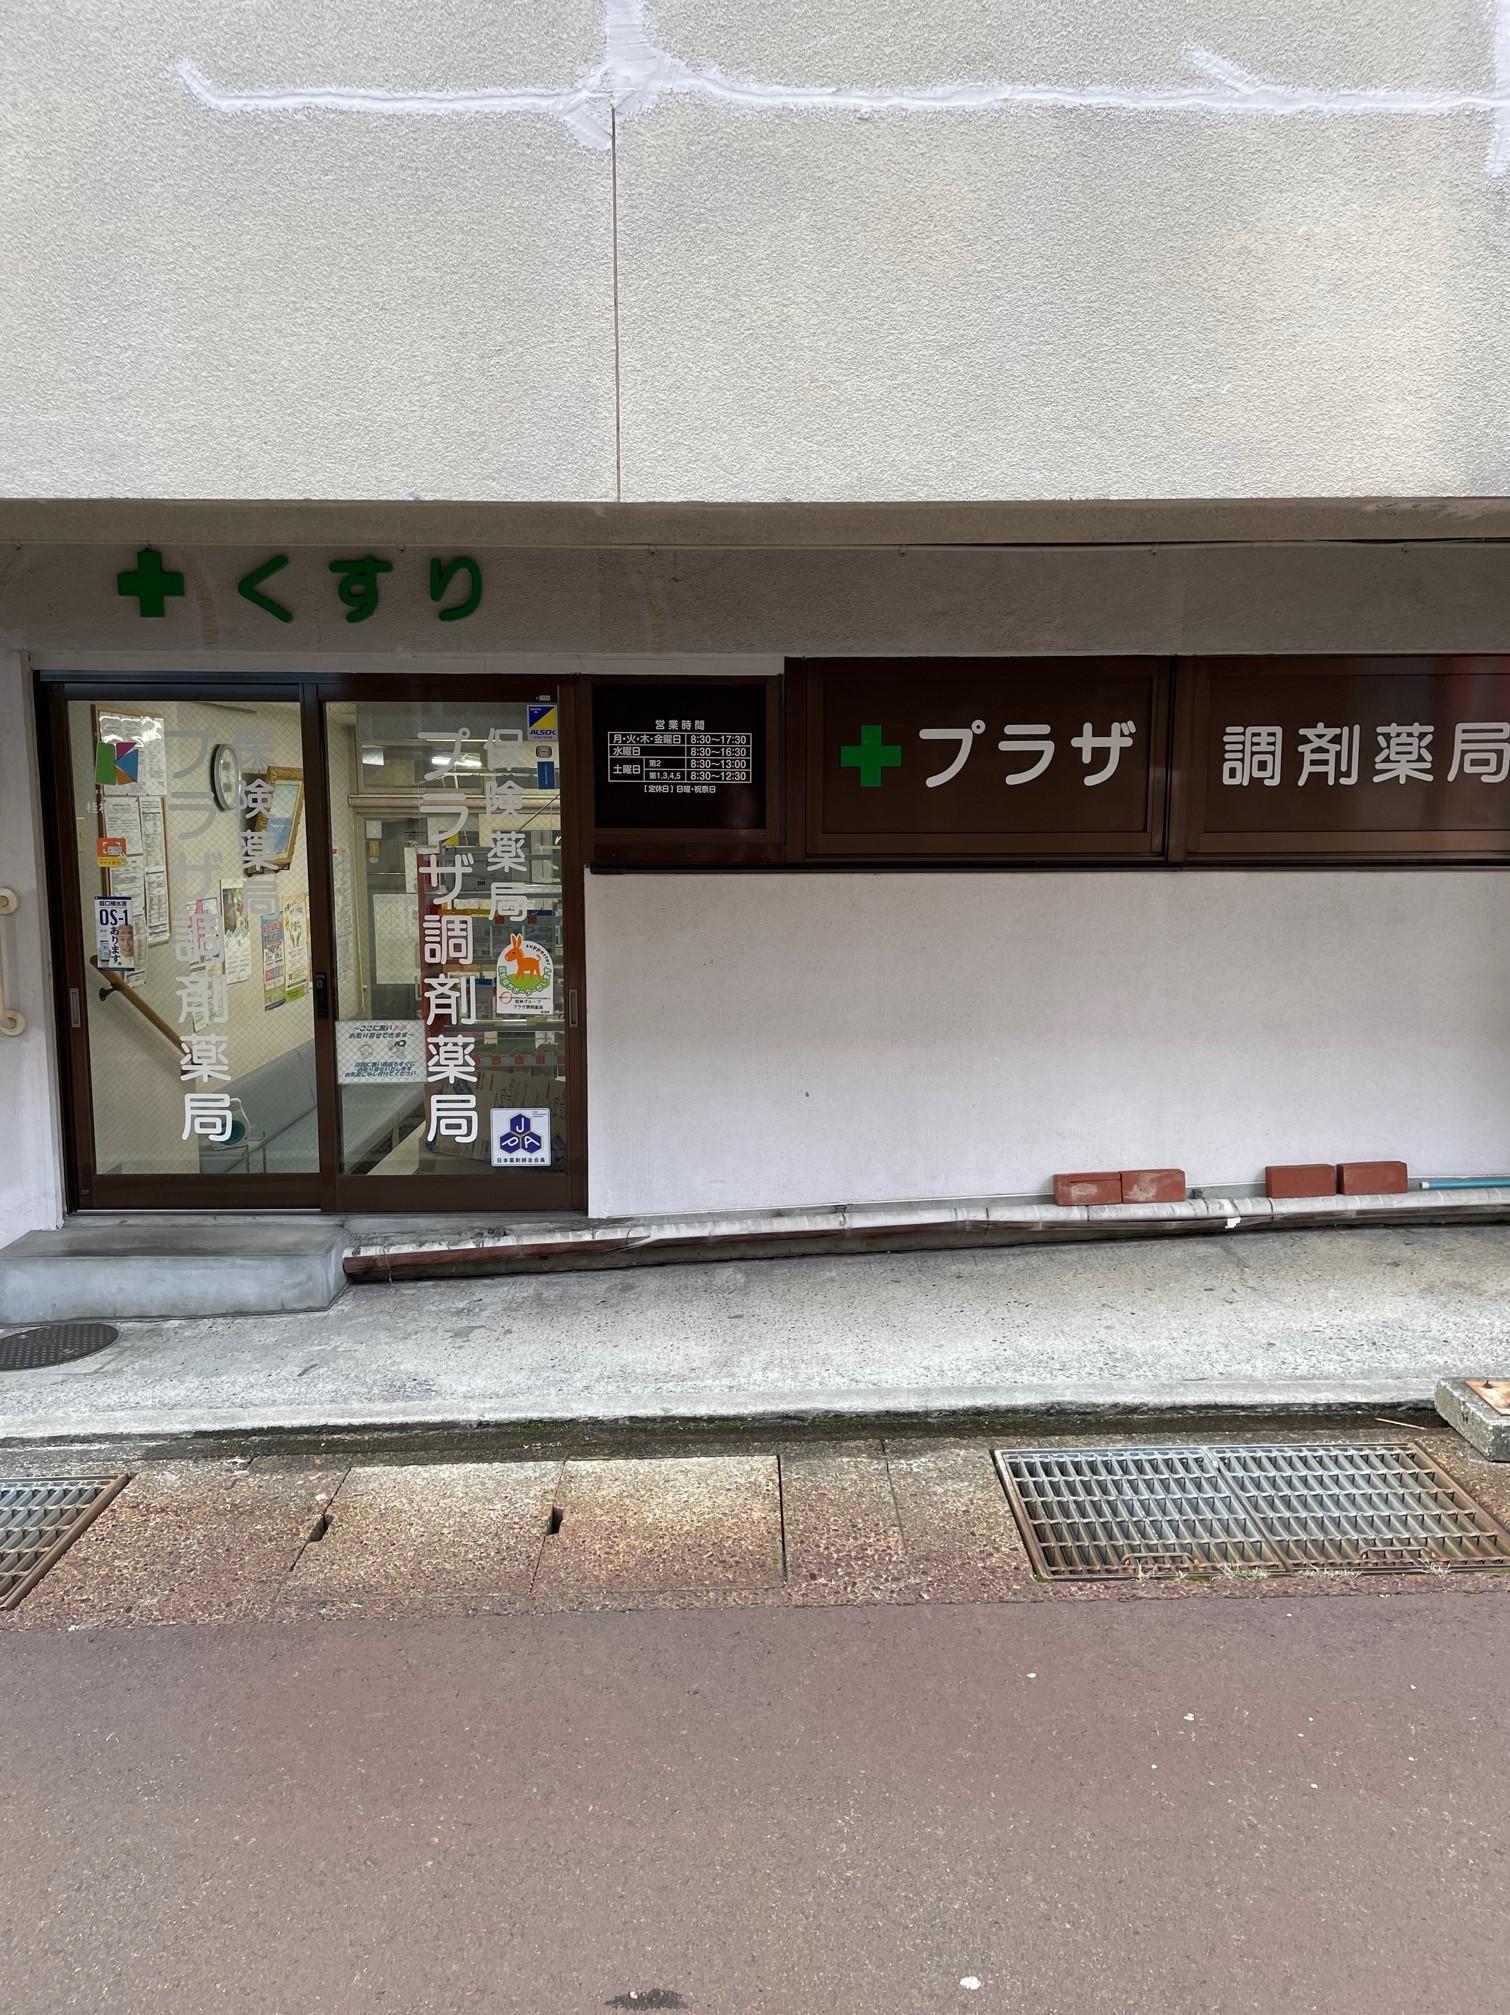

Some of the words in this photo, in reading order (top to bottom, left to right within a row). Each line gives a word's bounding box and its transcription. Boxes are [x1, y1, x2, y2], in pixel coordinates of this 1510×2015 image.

[237, 554, 482, 623] くすり
[655, 720, 705, 730] 営業時間
[613, 747, 641, 756] 水曜日
[613, 765, 641, 774] 土曜日
[919, 719, 1136, 787] プラザ
[1222, 722, 1510, 786] 調剤薬局
[483, 728, 528, 922] 保険薬局
[99, 909, 128, 926] OS-1
[417, 727, 478, 1144] プラザ調剤薬局
